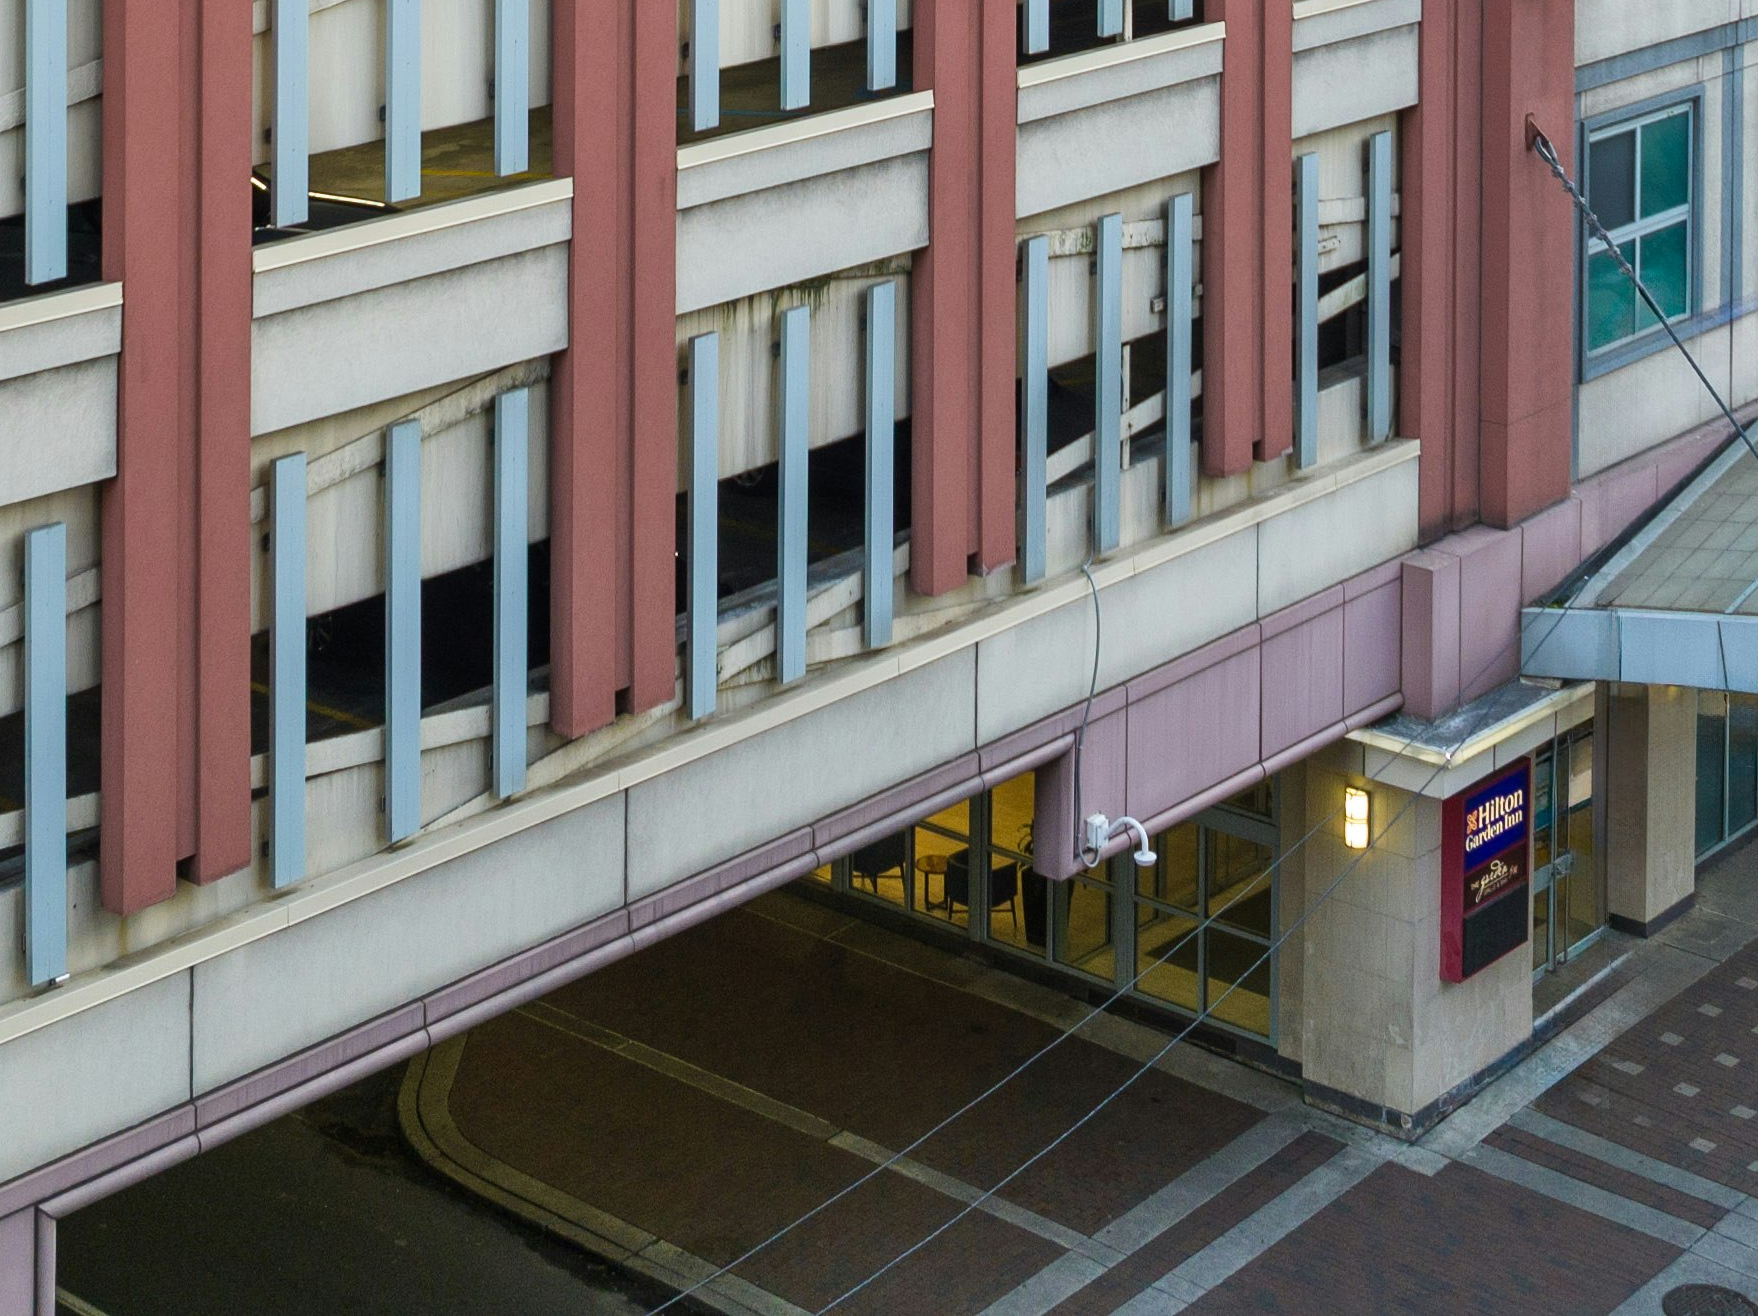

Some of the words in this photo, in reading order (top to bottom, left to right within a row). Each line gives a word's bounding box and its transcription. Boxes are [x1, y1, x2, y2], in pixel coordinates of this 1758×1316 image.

[1478, 789, 1523, 828] Hilton
[1465, 821, 1503, 852] Garden
[1504, 810, 1523, 830] Inn
